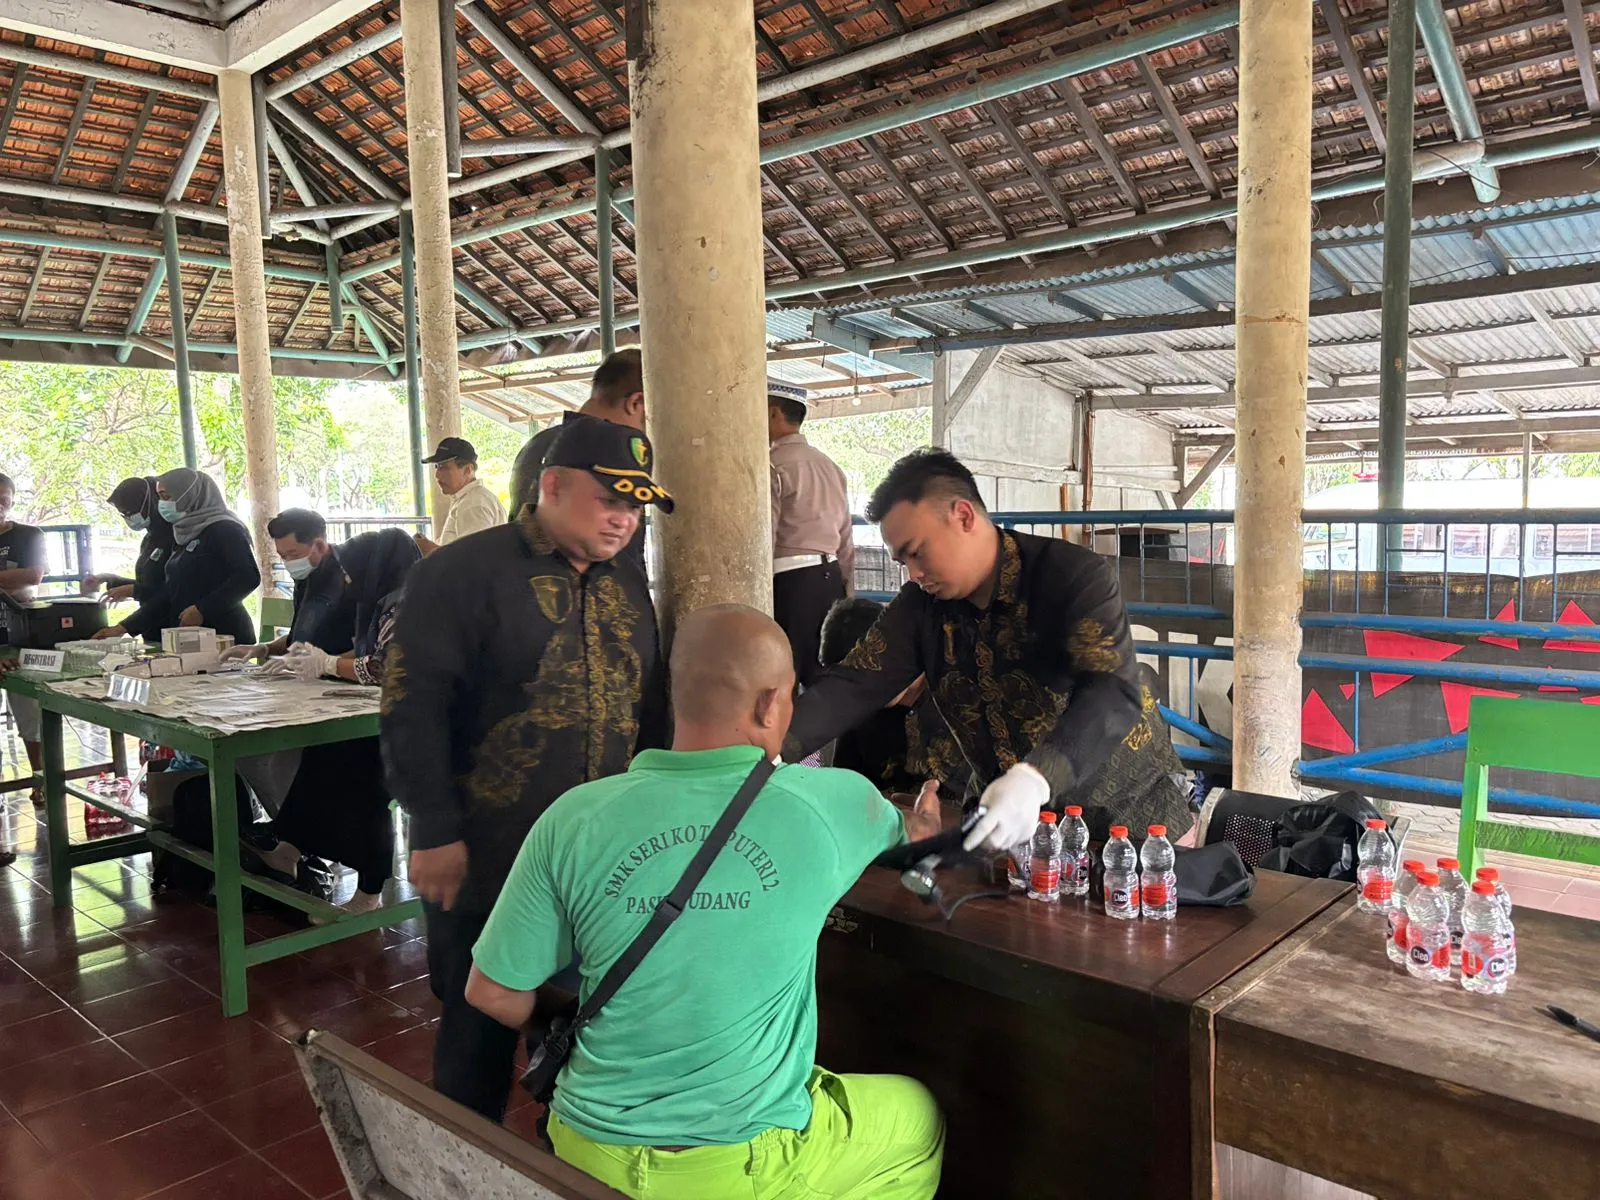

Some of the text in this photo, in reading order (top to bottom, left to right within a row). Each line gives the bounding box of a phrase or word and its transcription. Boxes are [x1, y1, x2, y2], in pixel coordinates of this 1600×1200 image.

[604, 861, 635, 898] SMK
[629, 832, 669, 866] SERI
[670, 824, 711, 845] KOT
[688, 890, 751, 911] UDANG
